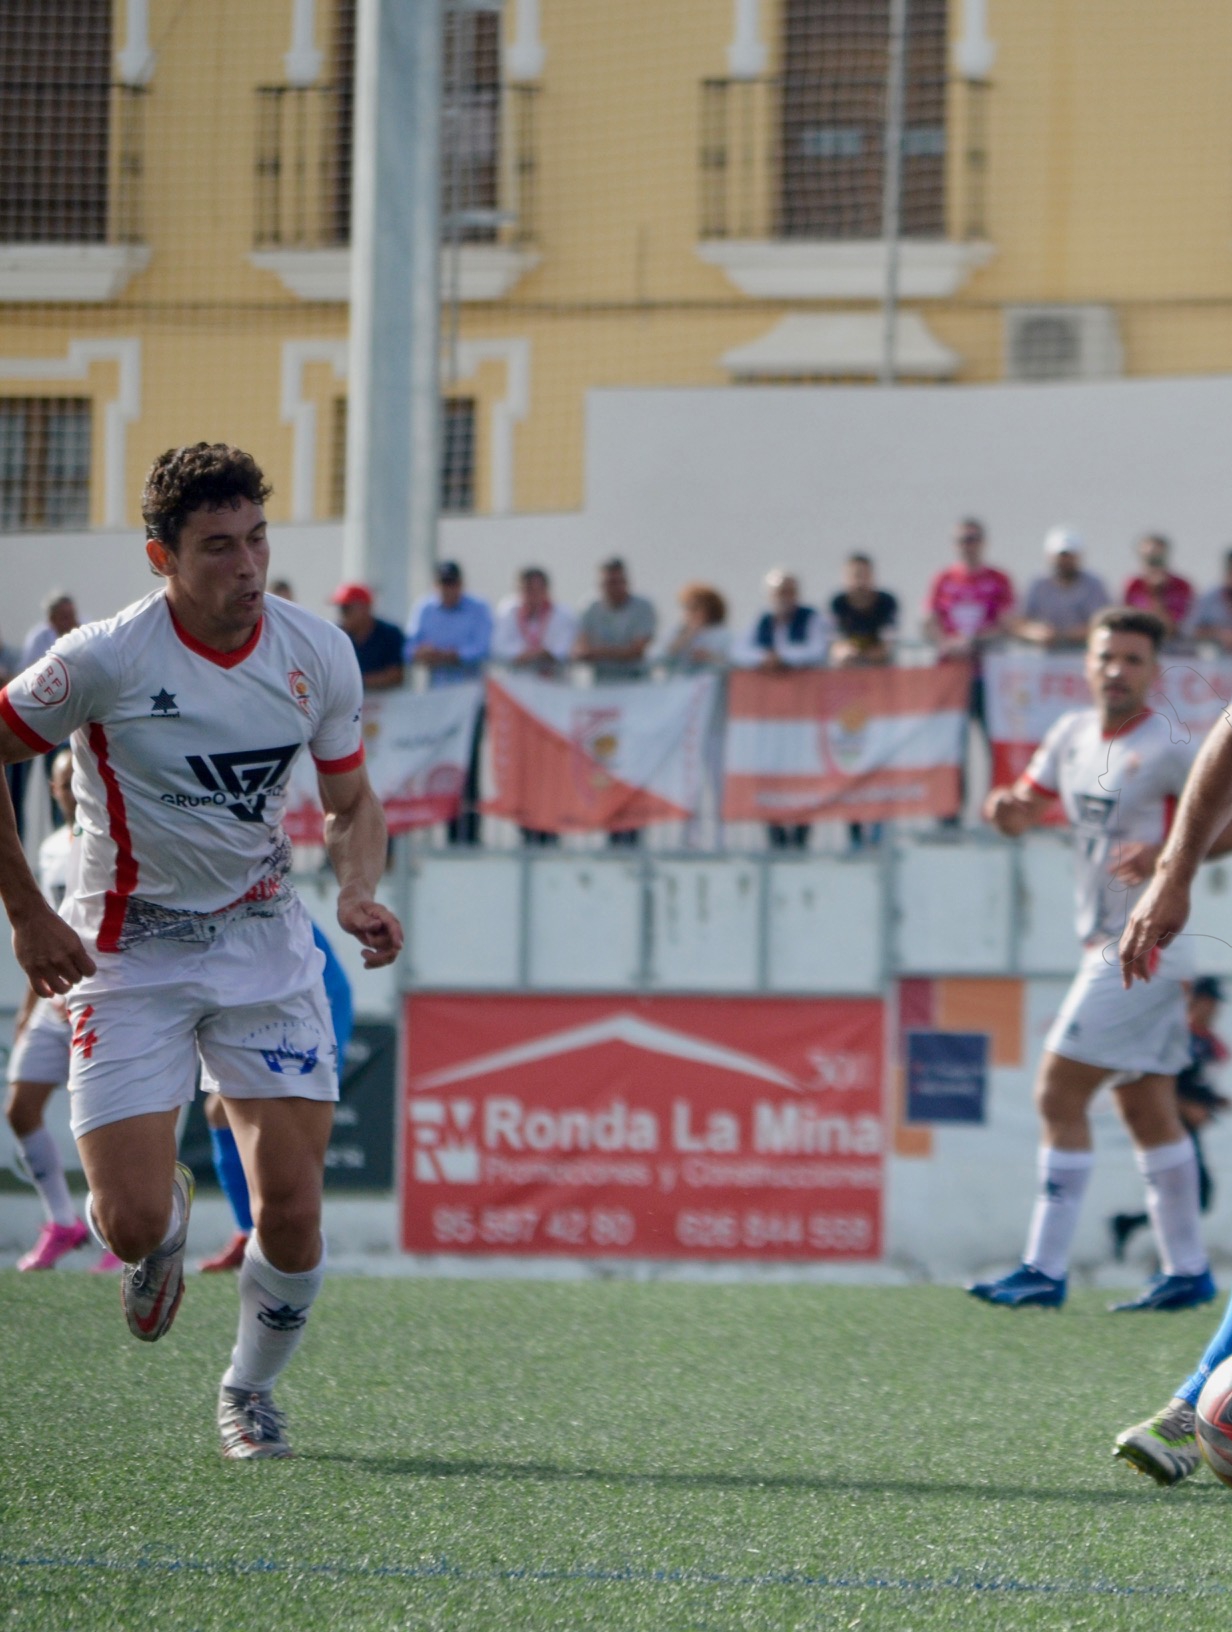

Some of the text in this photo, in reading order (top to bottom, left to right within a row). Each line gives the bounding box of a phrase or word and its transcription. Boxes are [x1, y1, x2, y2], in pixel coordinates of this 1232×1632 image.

[160, 792, 227, 808] GRUPO
[483, 1097, 883, 1155] Ronda La Mina
